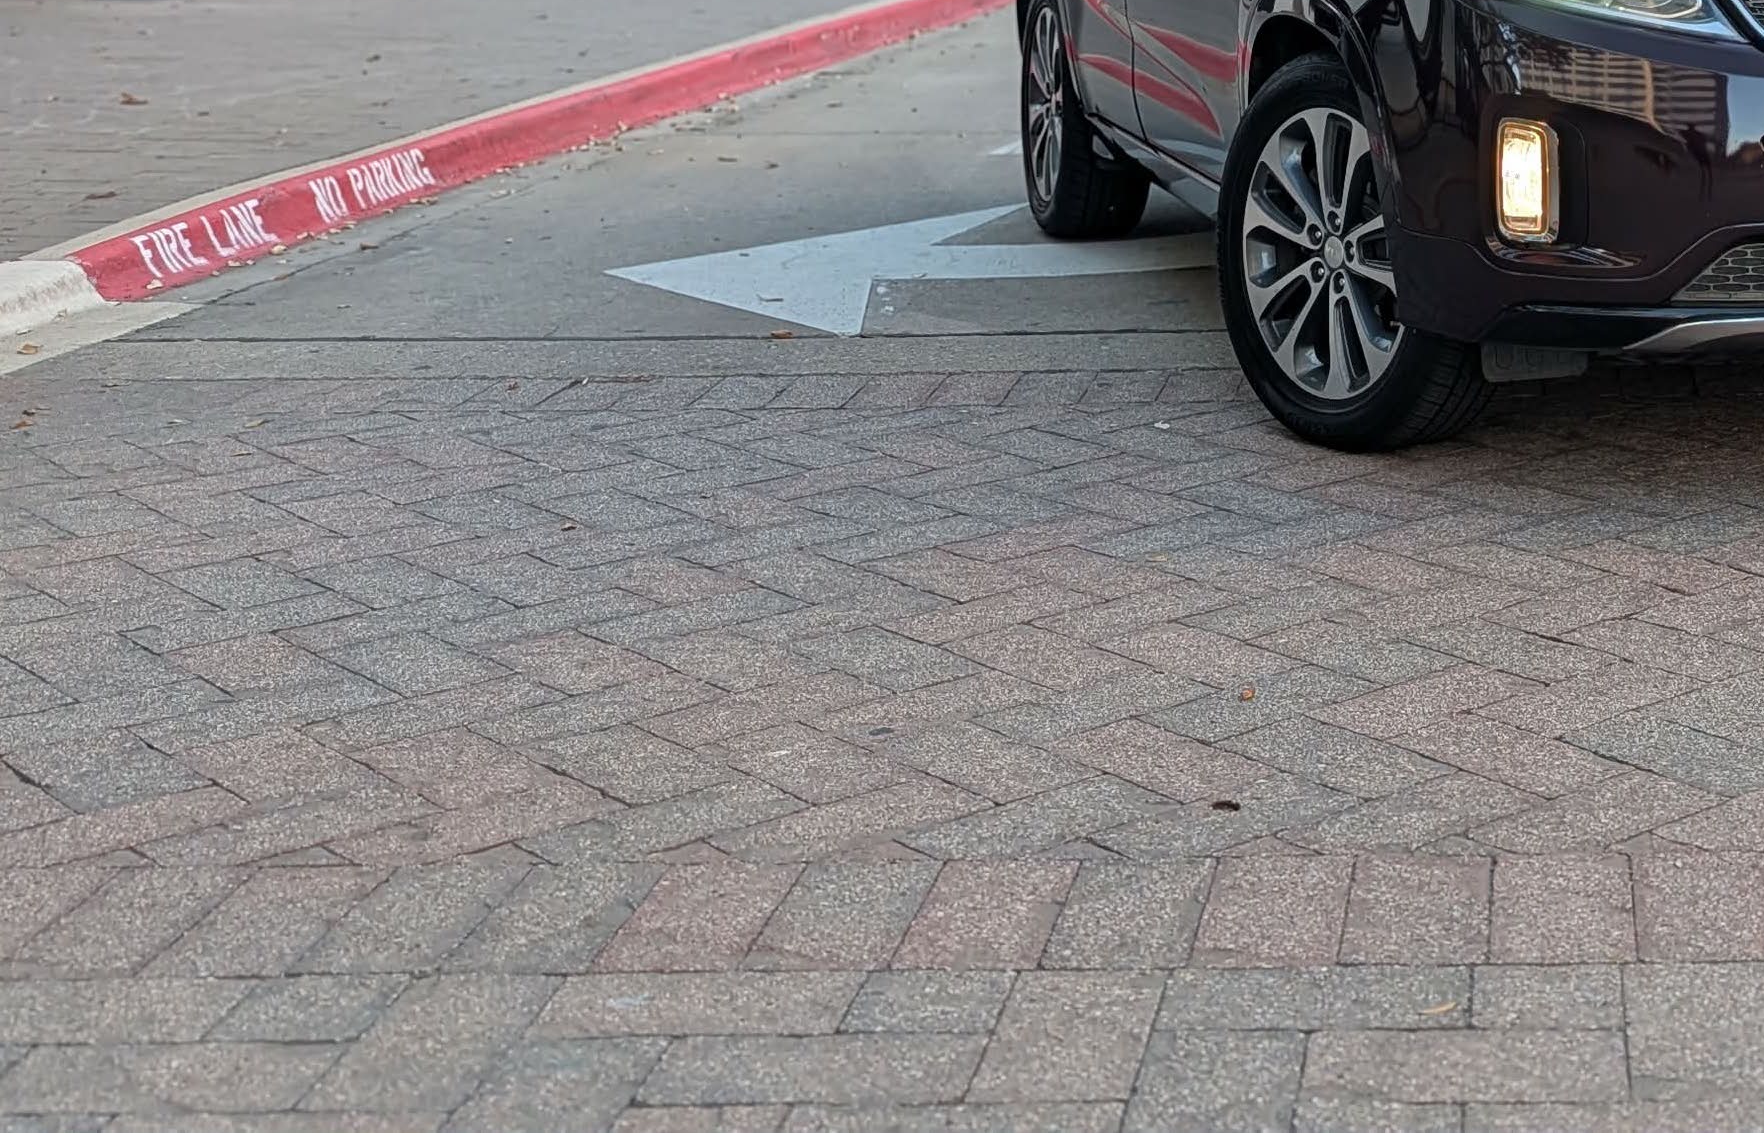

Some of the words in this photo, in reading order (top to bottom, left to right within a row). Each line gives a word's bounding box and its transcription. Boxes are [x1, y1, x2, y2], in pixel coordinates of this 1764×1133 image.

[130, 221, 209, 279] FIRE
[200, 197, 280, 258] LANE
[308, 175, 349, 224] NO
[345, 148, 437, 211] PARKING
